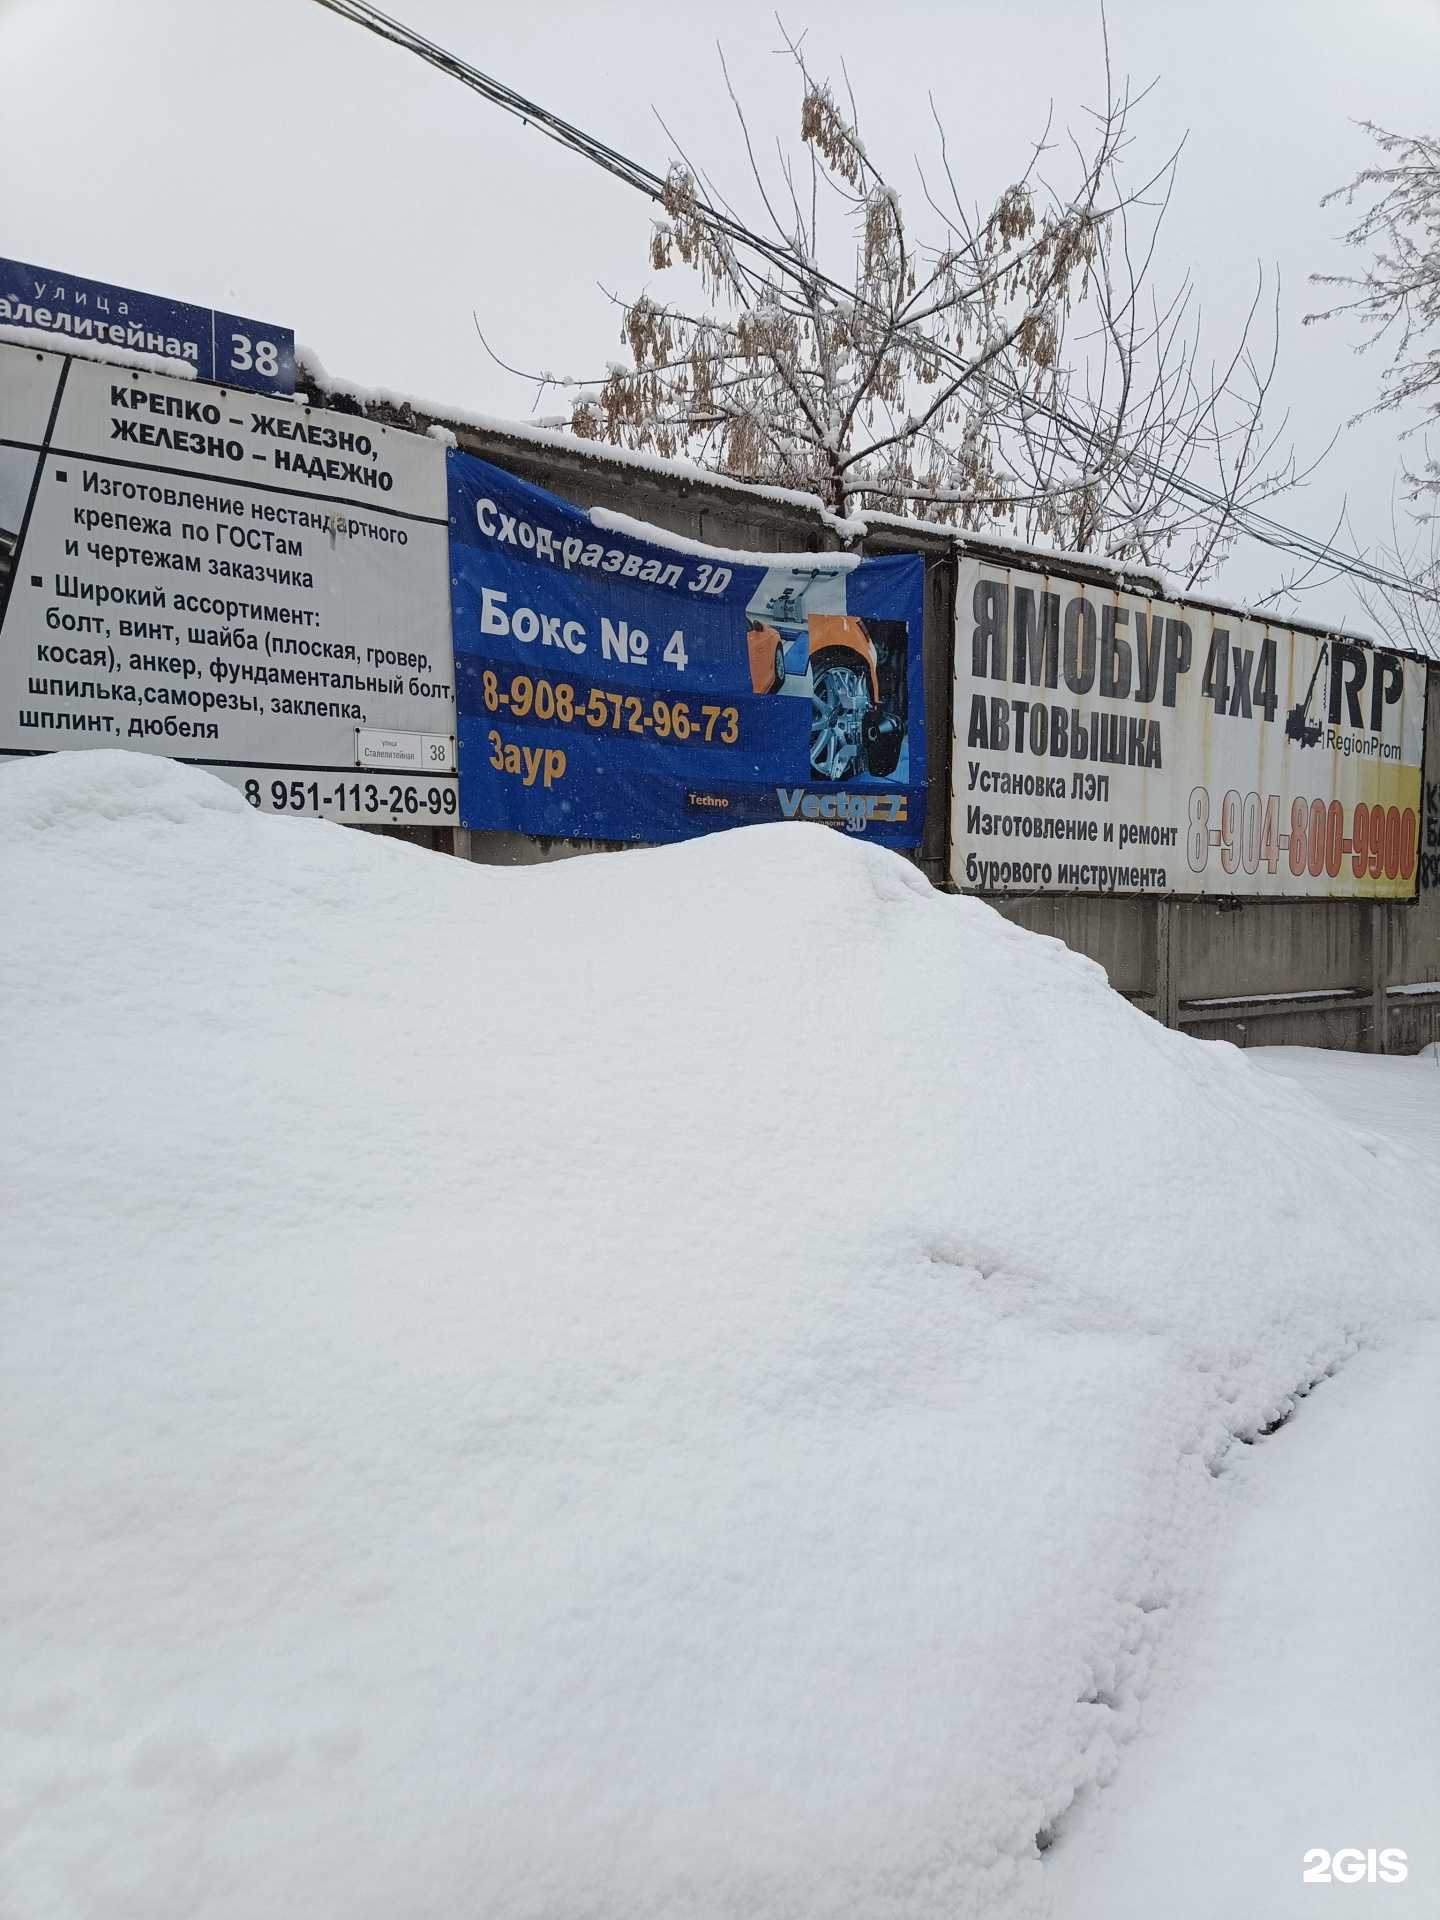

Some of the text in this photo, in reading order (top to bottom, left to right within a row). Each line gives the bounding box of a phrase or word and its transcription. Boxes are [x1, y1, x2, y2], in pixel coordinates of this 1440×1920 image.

[34, 281, 129, 314] улица
[230, 334, 279, 377] 38
[110, 385, 221, 425] КРЕПКО
[250, 412, 378, 462] ЖЕЛЕЗНО,
[110, 418, 244, 462] ЖЕЛЕЗНО
[274, 449, 393, 491] НАДЕЖНО
[74, 507, 303, 556] крепежа по ГОСТам
[82, 470, 408, 546] Изготовление нестандартного
[65, 540, 314, 588] и чертежам заказчика
[476, 498, 733, 594] Сход-развал 3D
[55, 574, 320, 627] Широкий ассортимент:
[46, 607, 432, 673] болт, винт, шайба (плоская, гровер,
[480, 587, 689, 672] Бокс № 4
[971, 579, 1192, 708] ЯМОБУР
[37, 644, 455, 704] косая), анкер, фундаментальный болт,
[1328, 642, 1404, 731] RP
[19, 710, 219, 739] шплинт, дюбеля
[270, 697, 367, 723] заклепка,
[482, 670, 740, 743] 8-908-572-96-73
[967, 694, 1162, 769] АВТОВЫШКА
[430, 745, 446, 762] 38
[488, 730, 567, 788] Заур
[1326, 730, 1401, 760] RegionProm
[245, 779, 457, 815] 8 951-113-26-99
[688, 794, 729, 808] Techno
[776, 788, 875, 819] Vector
[967, 761, 1110, 802] Установка ЛЭП
[846, 817, 867, 832] 3D
[966, 805, 1178, 849] Изготовление и ремонт
[1186, 786, 1417, 880] 8-904-800-9900
[966, 852, 1167, 891] бурового инструмента
